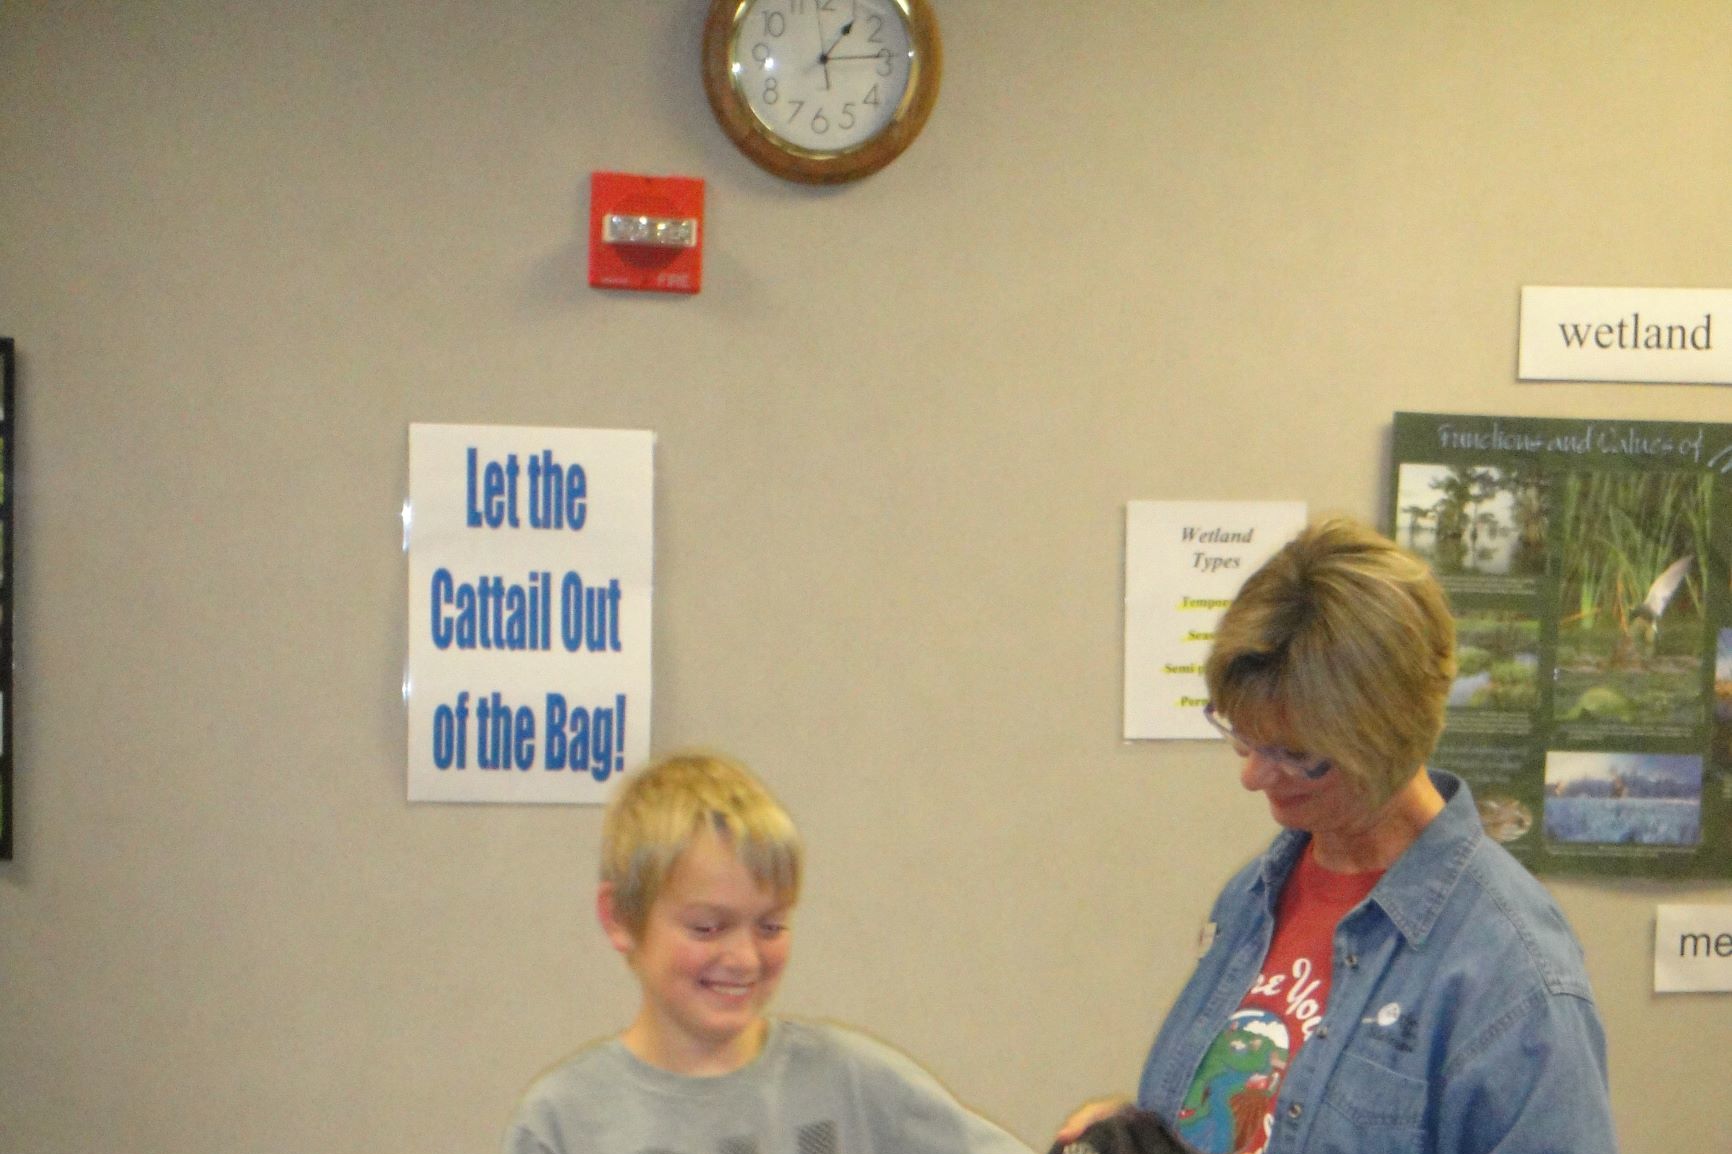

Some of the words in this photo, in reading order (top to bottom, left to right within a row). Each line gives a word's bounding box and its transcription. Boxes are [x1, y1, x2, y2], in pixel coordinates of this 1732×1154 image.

[761, 10, 785, 38] 10
[866, 14, 883, 43] 2
[876, 47, 893, 77] 3
[762, 76, 778, 105] 8
[862, 83, 880, 109] 4
[788, 99, 805, 124] 7
[810, 107, 830, 135] 6
[838, 102, 856, 130] 5
[1558, 312, 1713, 350] wetland
[466, 447, 520, 528] Let
[528, 449, 588, 531] the
[1181, 526, 1255, 544] Wetland
[1192, 552, 1242, 573] Types
[431, 567, 552, 650] Cattail
[561, 570, 622, 653] Out
[432, 691, 469, 770] of
[477, 692, 536, 771] the
[544, 692, 627, 782] Bag!
